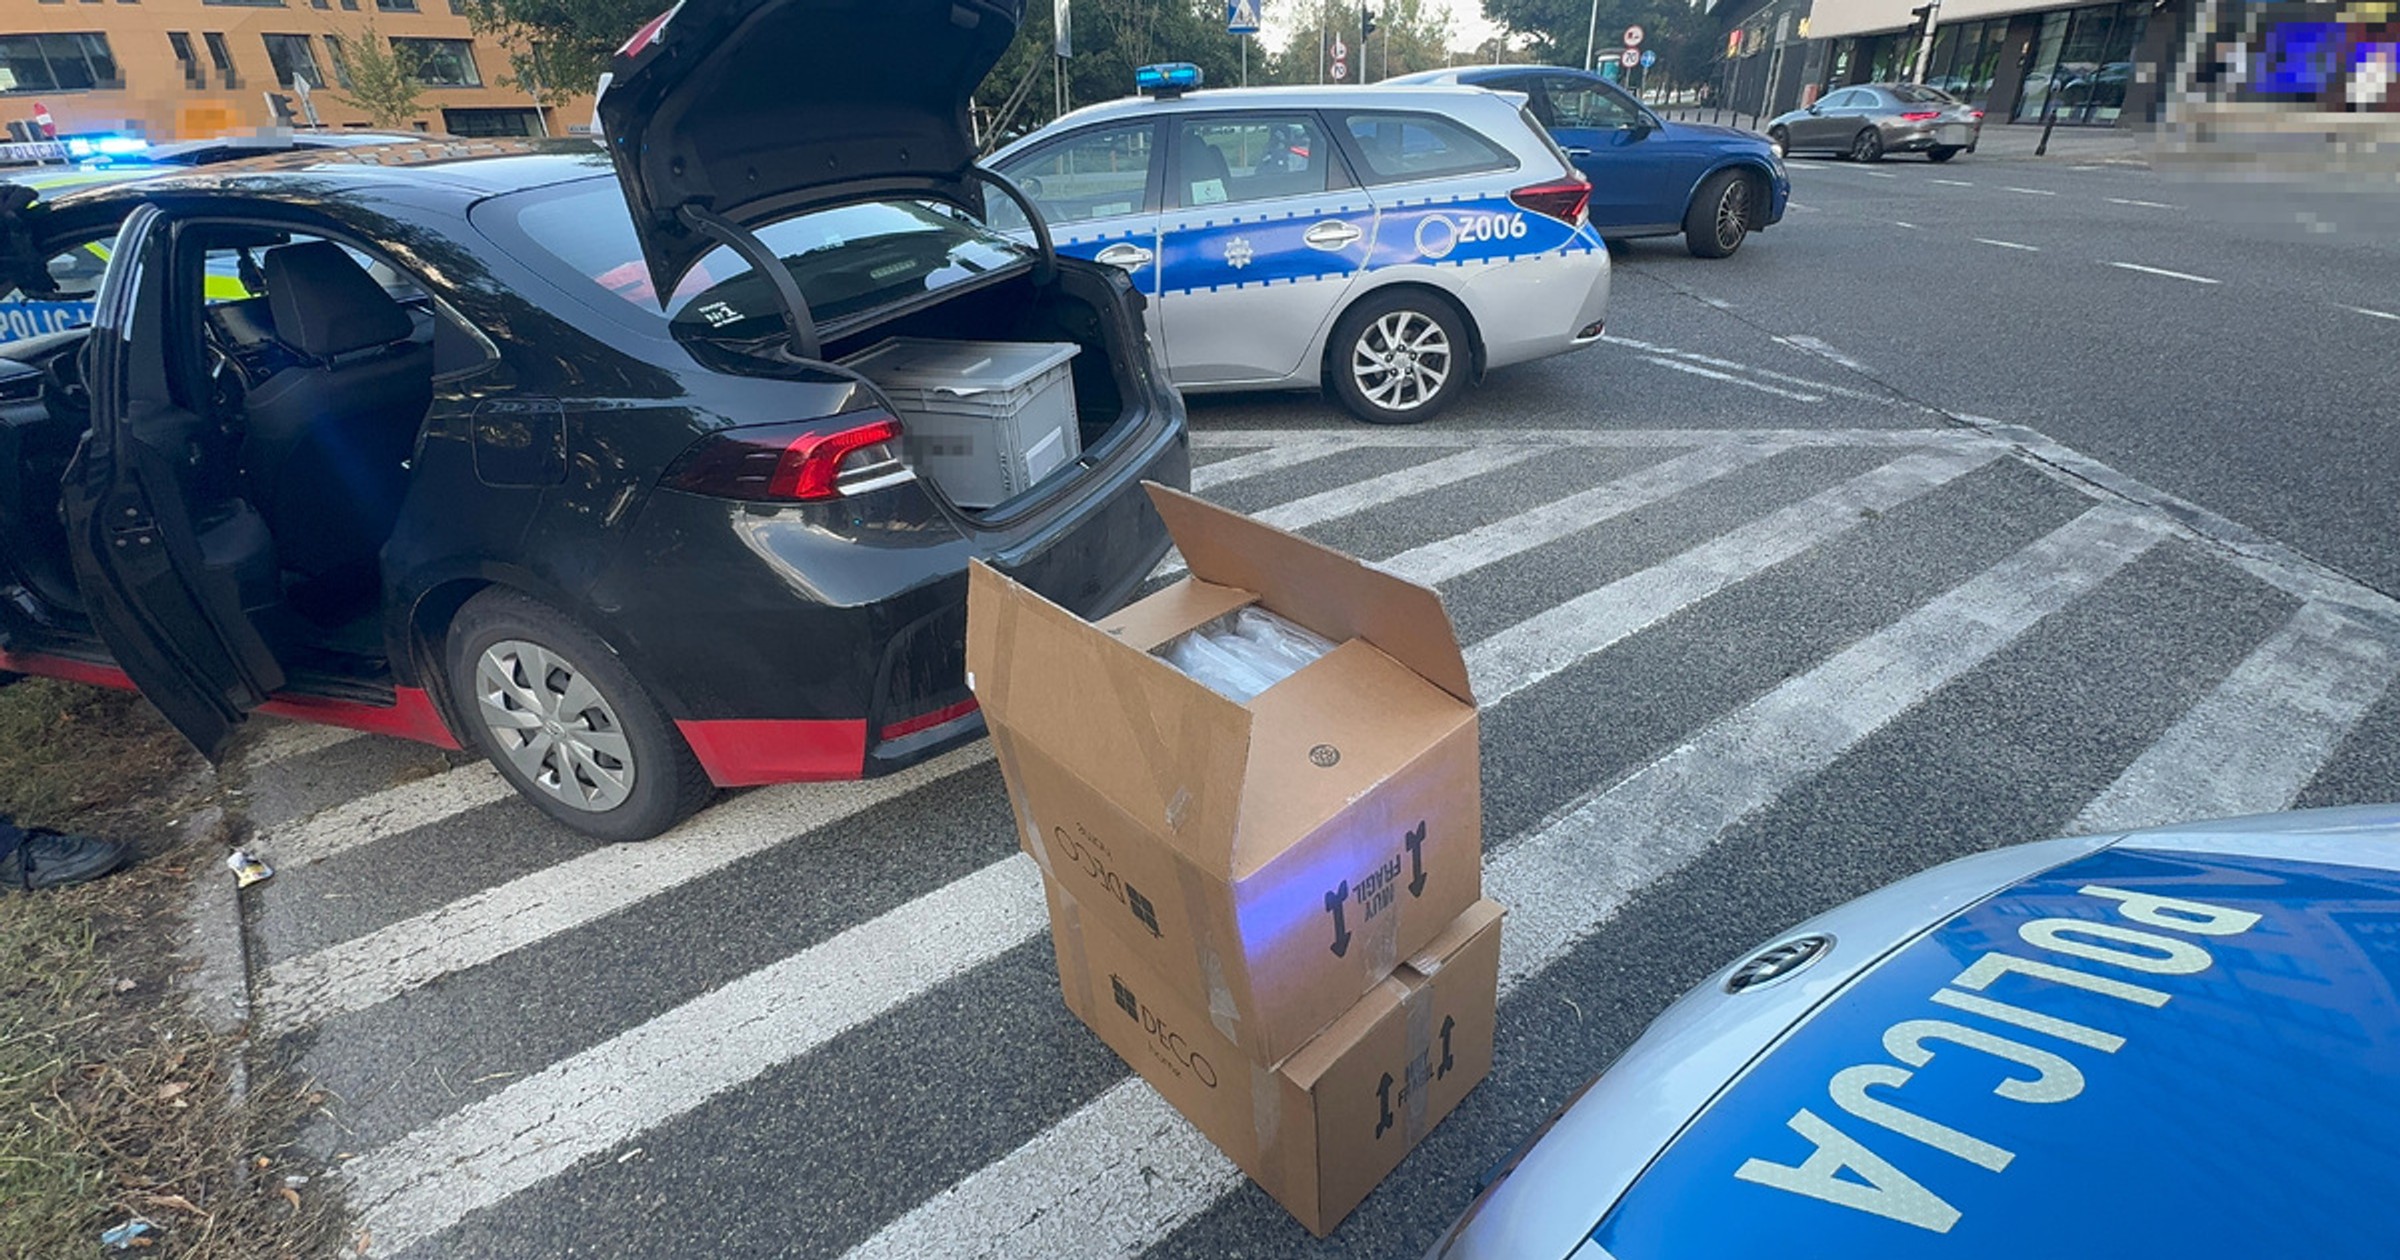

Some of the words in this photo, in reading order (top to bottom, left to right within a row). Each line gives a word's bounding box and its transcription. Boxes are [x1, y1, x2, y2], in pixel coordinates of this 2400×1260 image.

[1459, 212, 1527, 243] Z006
[1054, 825, 1126, 905] DECO
[1352, 853, 1401, 905] FRAGIL
[1364, 882, 1395, 923] MUY
[1140, 1004, 1217, 1088] DECO
[1734, 884, 2263, 1234] POLICJA
